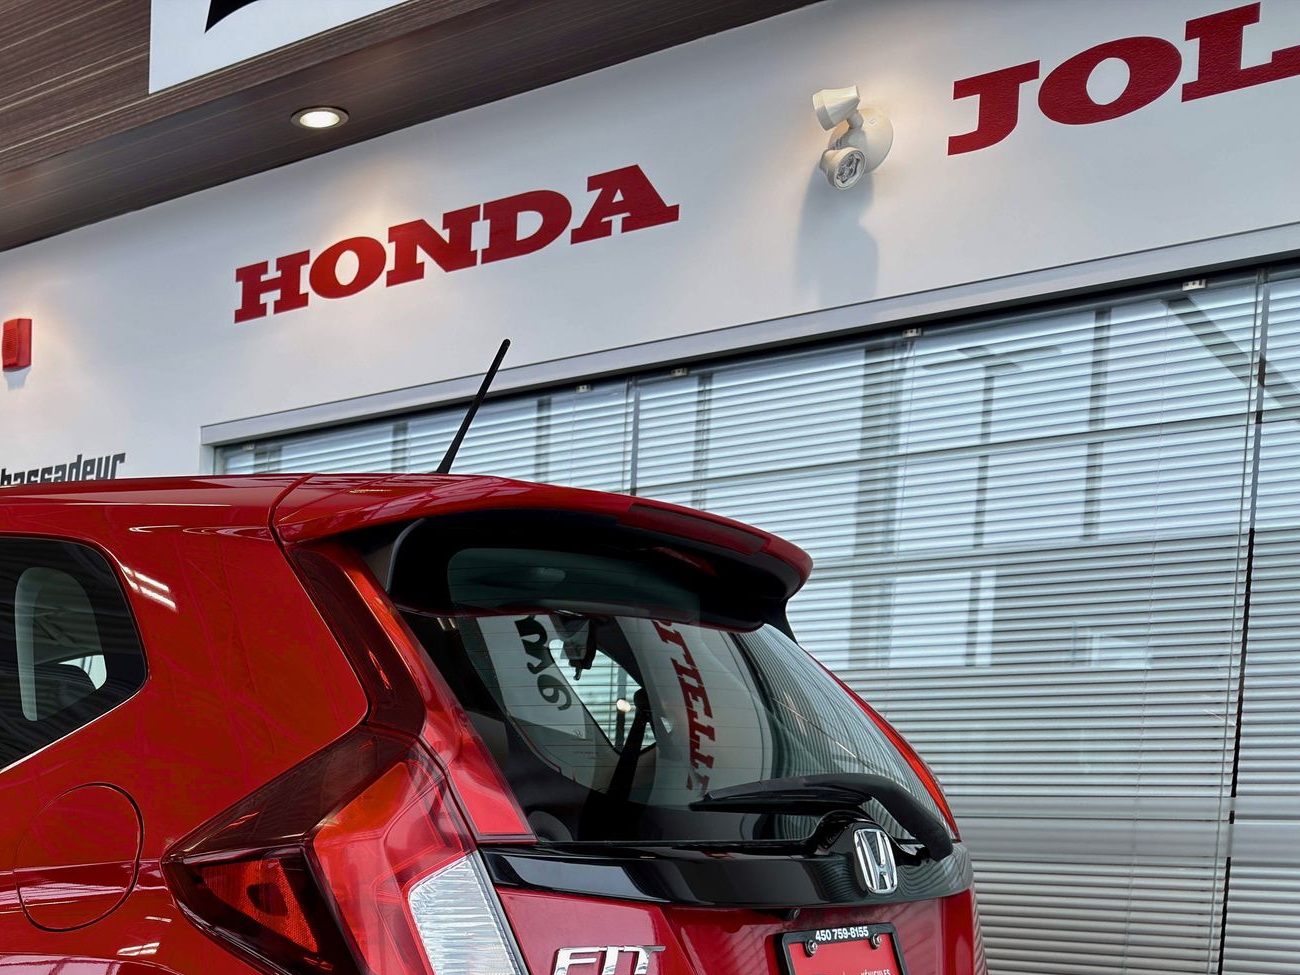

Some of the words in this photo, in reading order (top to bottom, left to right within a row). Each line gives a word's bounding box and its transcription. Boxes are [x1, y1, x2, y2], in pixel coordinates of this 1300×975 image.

[233, 163, 681, 324] HONDA
[815, 929, 832, 941] 450
[833, 926, 869, 940] 759-8155
